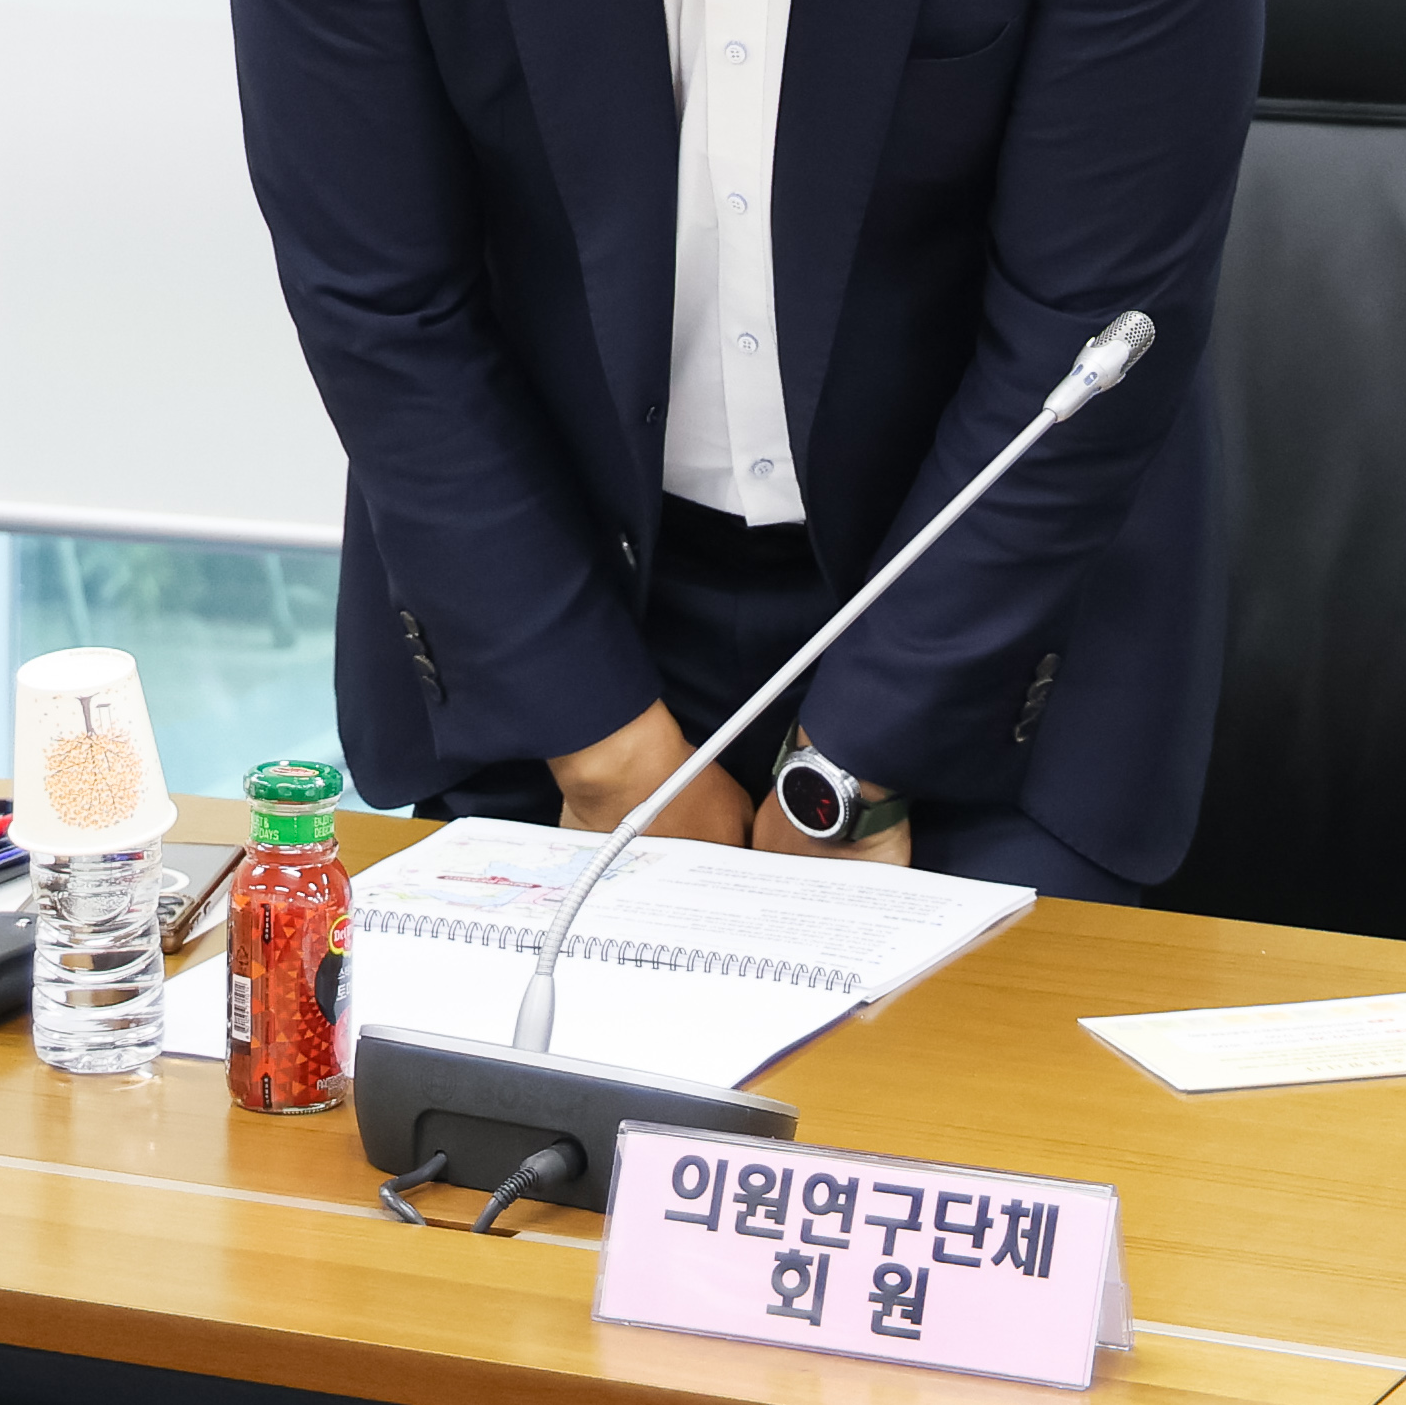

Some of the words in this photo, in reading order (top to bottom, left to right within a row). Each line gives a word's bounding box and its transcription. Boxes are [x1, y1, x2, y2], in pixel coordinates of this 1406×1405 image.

[664, 1154, 1059, 1279] 의원연구단체
[766, 1248, 831, 1327] 회
[868, 1262, 930, 1341] 원
